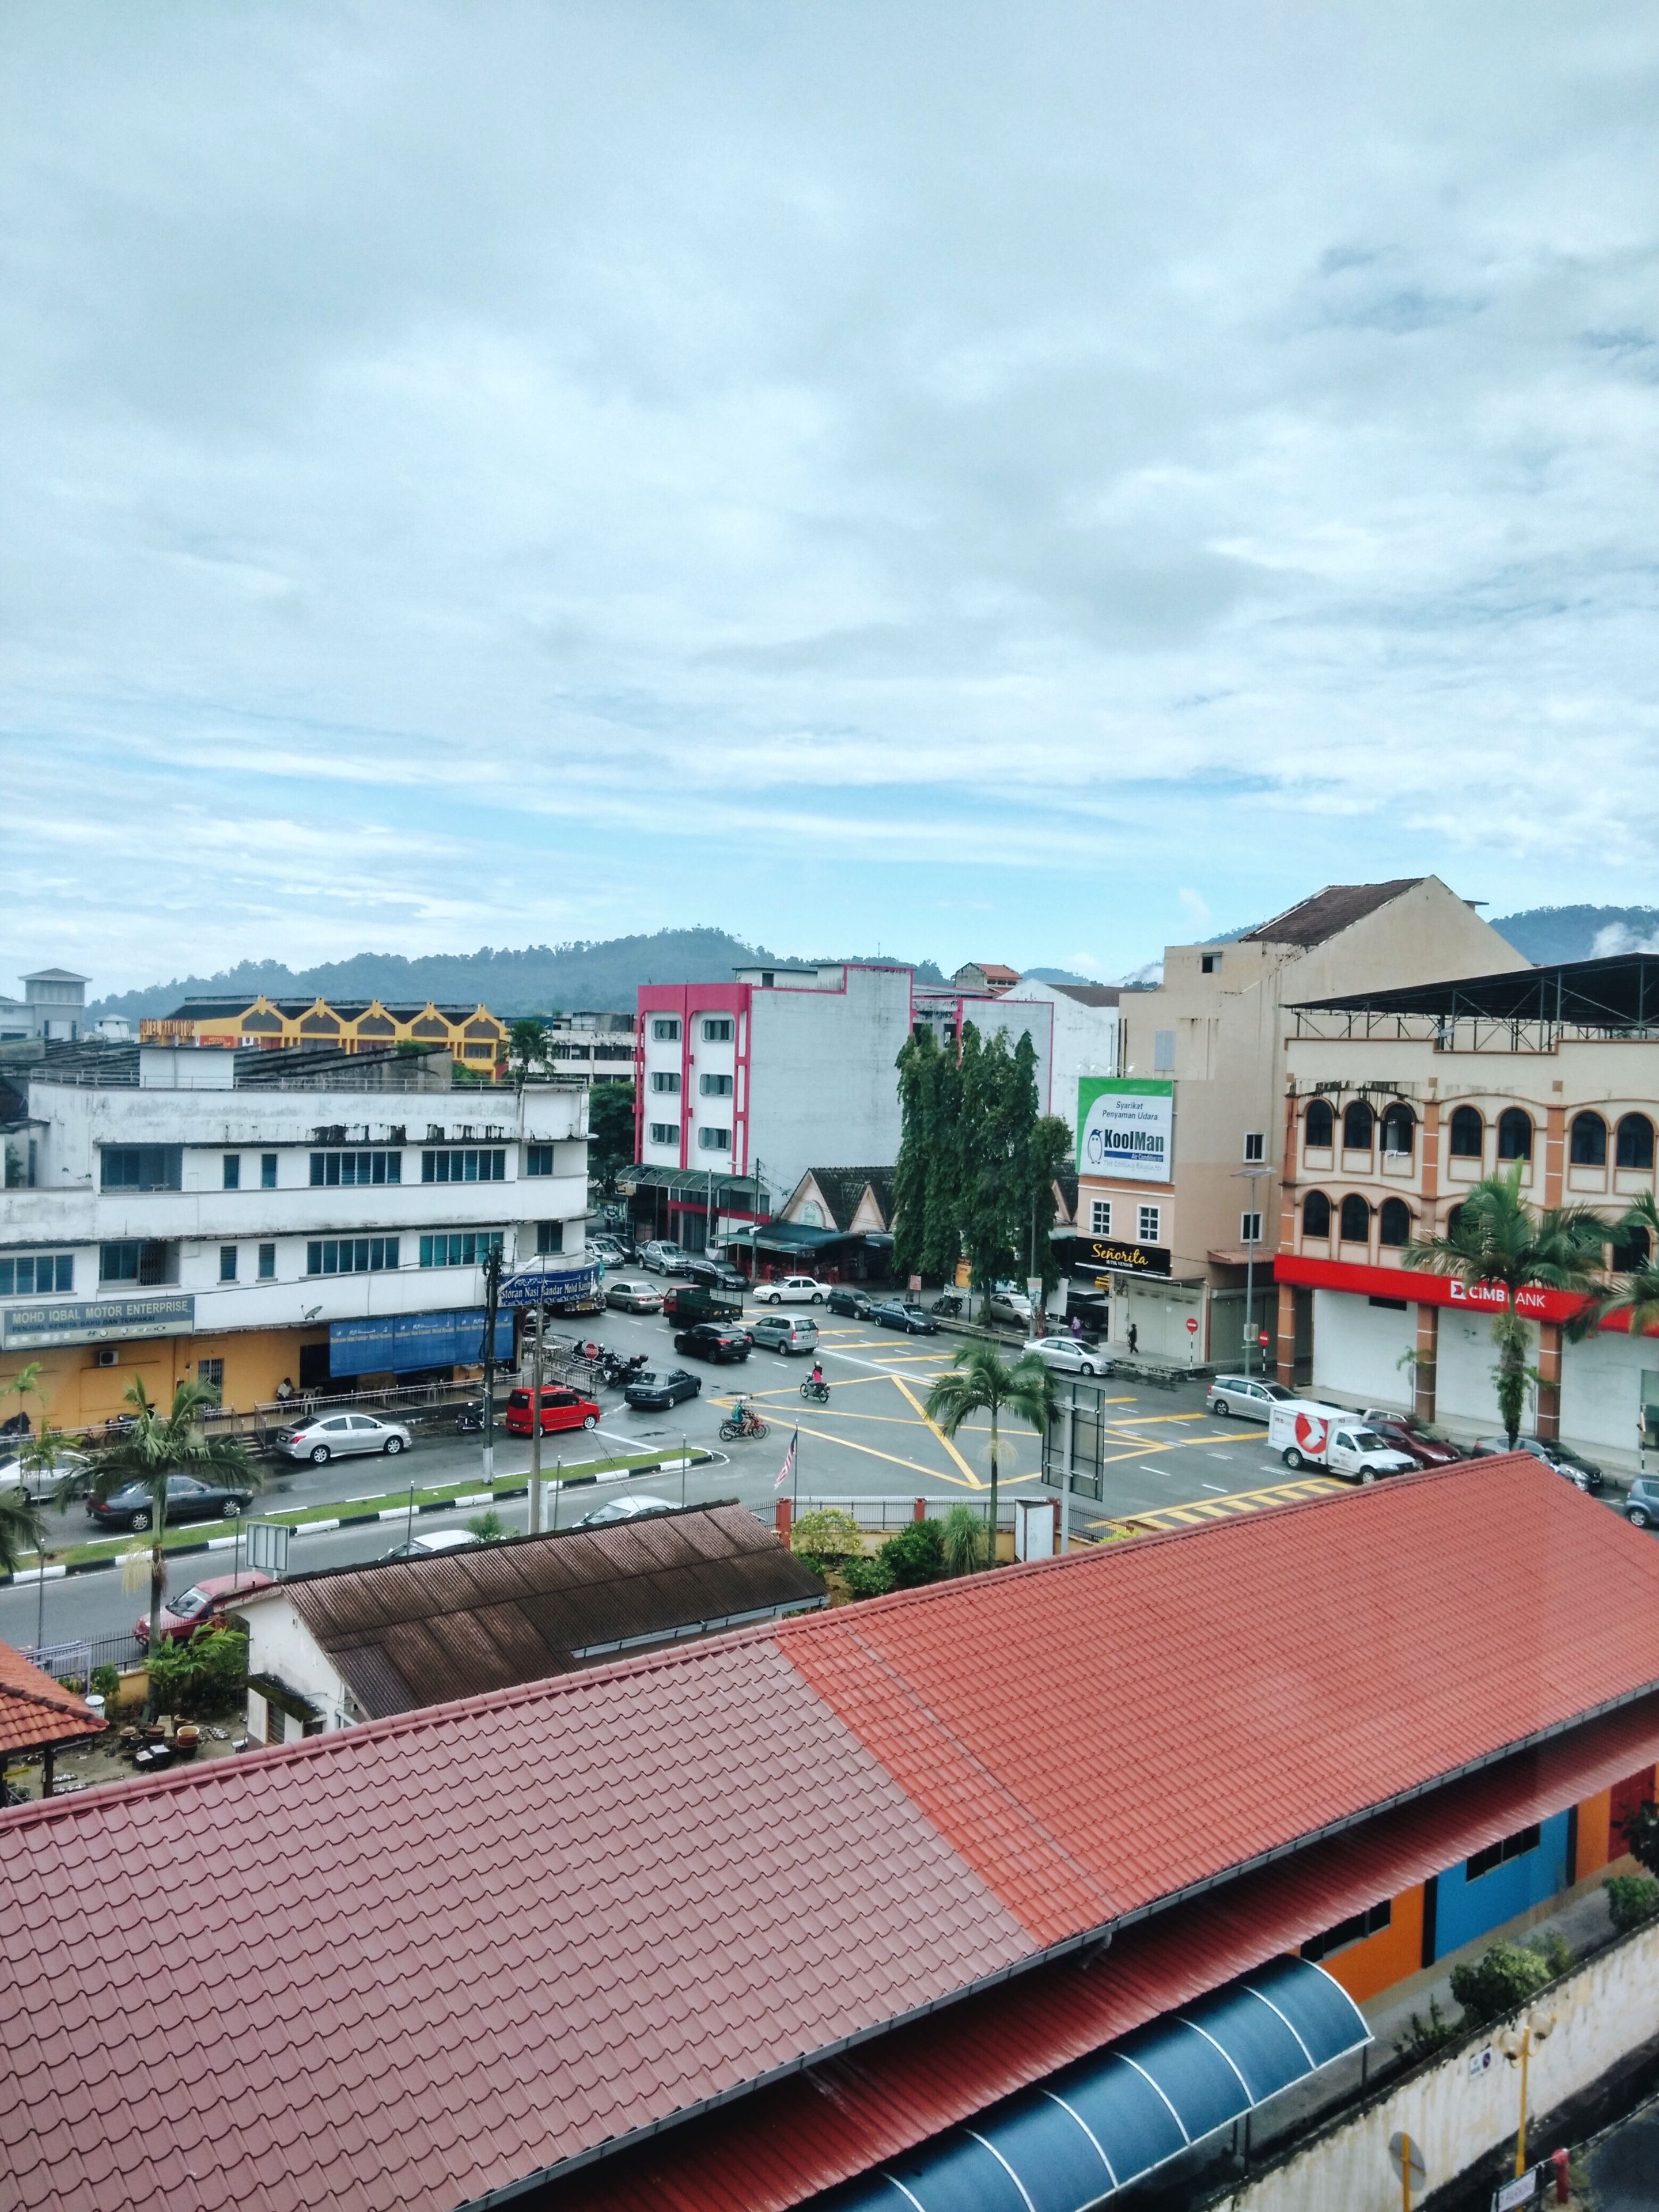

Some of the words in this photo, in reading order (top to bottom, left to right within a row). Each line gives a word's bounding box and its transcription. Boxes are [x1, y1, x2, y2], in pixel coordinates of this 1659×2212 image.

[1103, 1110, 1135, 1119] Penyaman
[1116, 1101, 1143, 1110] Syarikat
[1104, 1129, 1164, 1152] KoolMan
[1091, 1244, 1149, 1265] Señorita
[525, 1286, 539, 1297] Nasi
[565, 1283, 577, 1294] Mohd
[1469, 1286, 1505, 1302] CIMB
[1508, 1293, 1546, 1308] ANK
[13, 1312, 44, 1324] MOHD
[49, 1309, 81, 1322] IQBAL
[86, 1305, 122, 1319] MOTOR
[127, 1301, 188, 1315] ENTERPRISE
